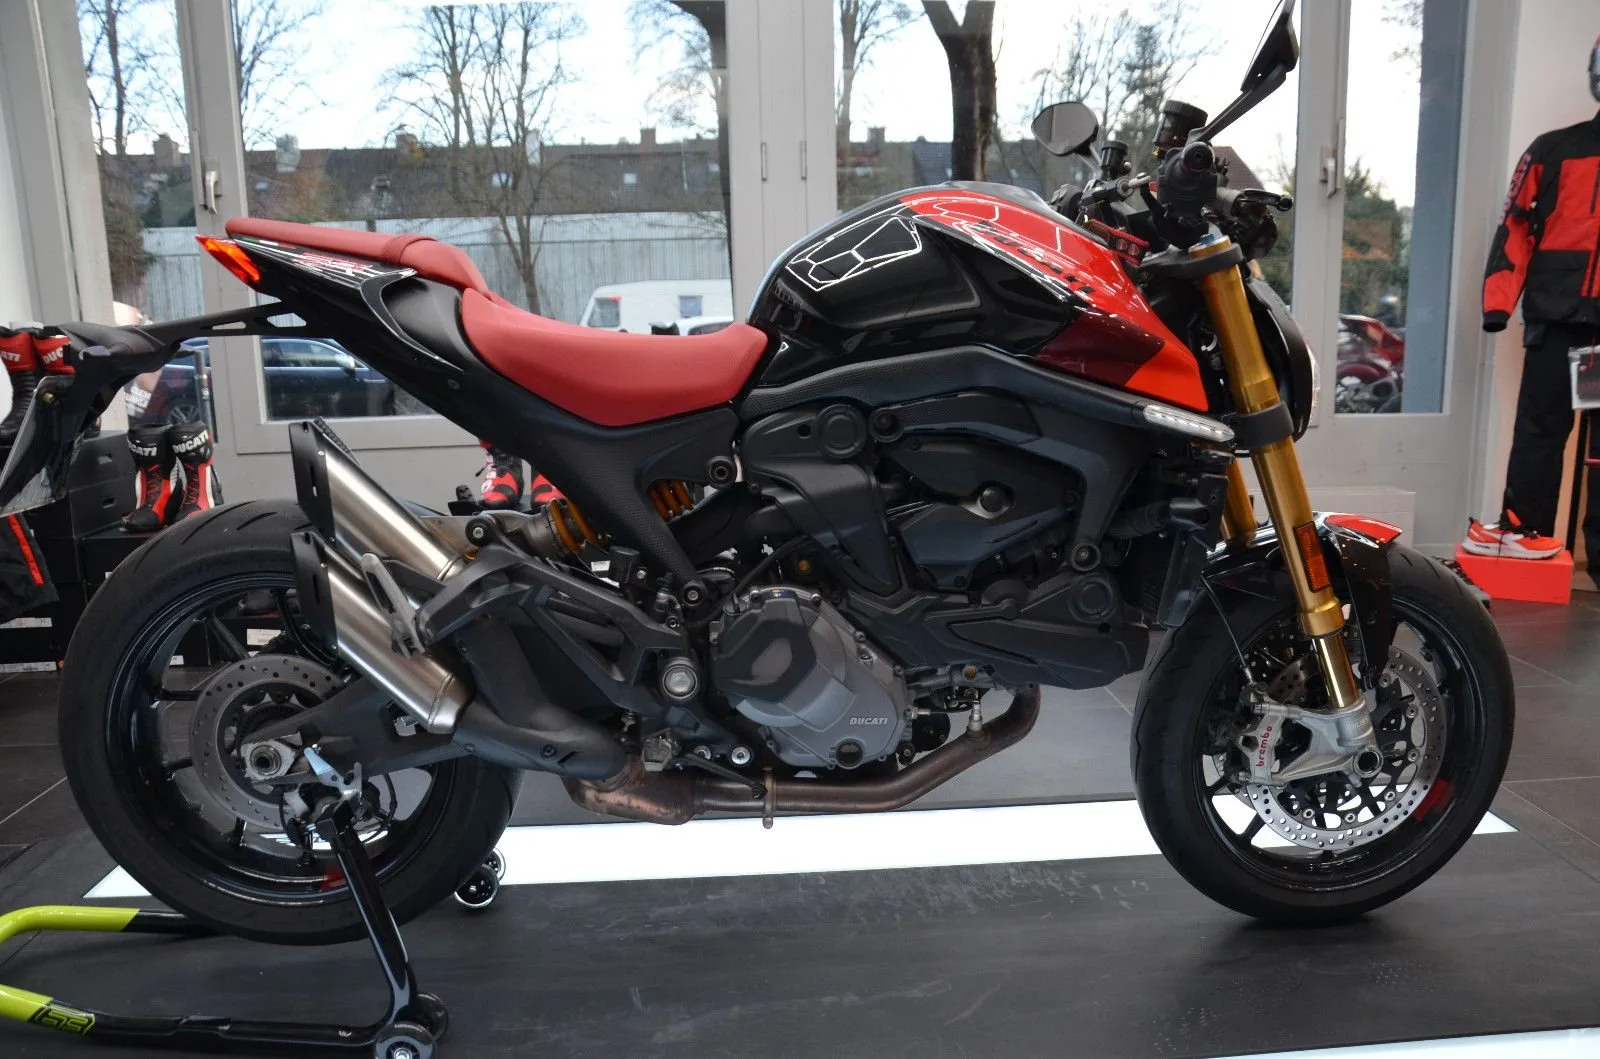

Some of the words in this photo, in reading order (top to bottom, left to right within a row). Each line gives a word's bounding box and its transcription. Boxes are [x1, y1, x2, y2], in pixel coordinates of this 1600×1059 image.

[43, 346, 64, 365] DUC
[172, 430, 209, 454] DUCATI
[850, 717, 889, 725] DUCATI
[1256, 726, 1273, 767] brembo
